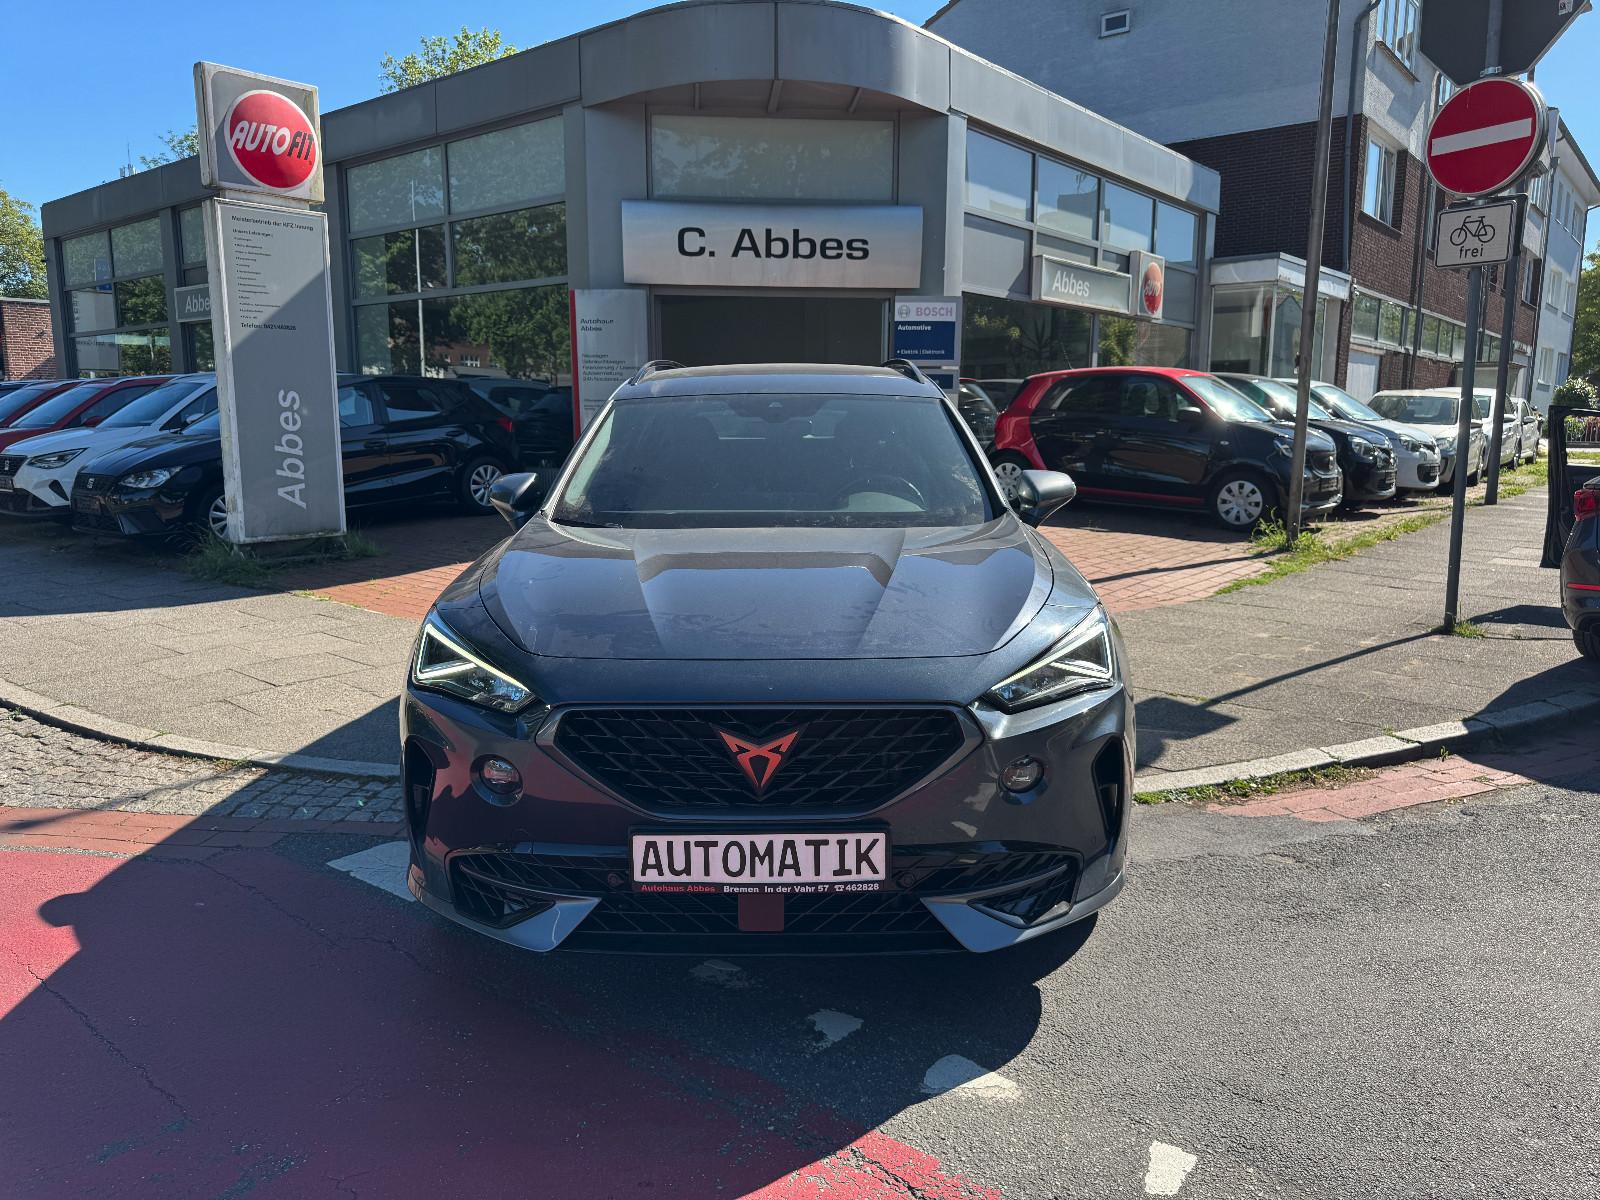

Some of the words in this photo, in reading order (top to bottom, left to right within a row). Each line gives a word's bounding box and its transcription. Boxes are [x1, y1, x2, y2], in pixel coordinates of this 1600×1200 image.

[231, 120, 314, 161] AUTOFIT
[677, 226, 715, 257] C.
[731, 228, 869, 260] Abbes
[1459, 244, 1484, 259] frei
[1052, 269, 1091, 297] Abbes
[185, 293, 211, 313] Abbe
[915, 306, 953, 317] BOSCH
[897, 323, 932, 331] Automotive
[274, 389, 307, 510] Abbes
[640, 838, 880, 878] AUTOMATIK
[641, 884, 685, 892] Autohaus
[686, 885, 716, 893] Abbes
[723, 884, 760, 893] Bremen
[764, 885, 774, 893] In
[775, 885, 792, 893] der
[793, 884, 816, 893] Vahr
[817, 884, 829, 892] 57
[845, 883, 880, 891] 462828
